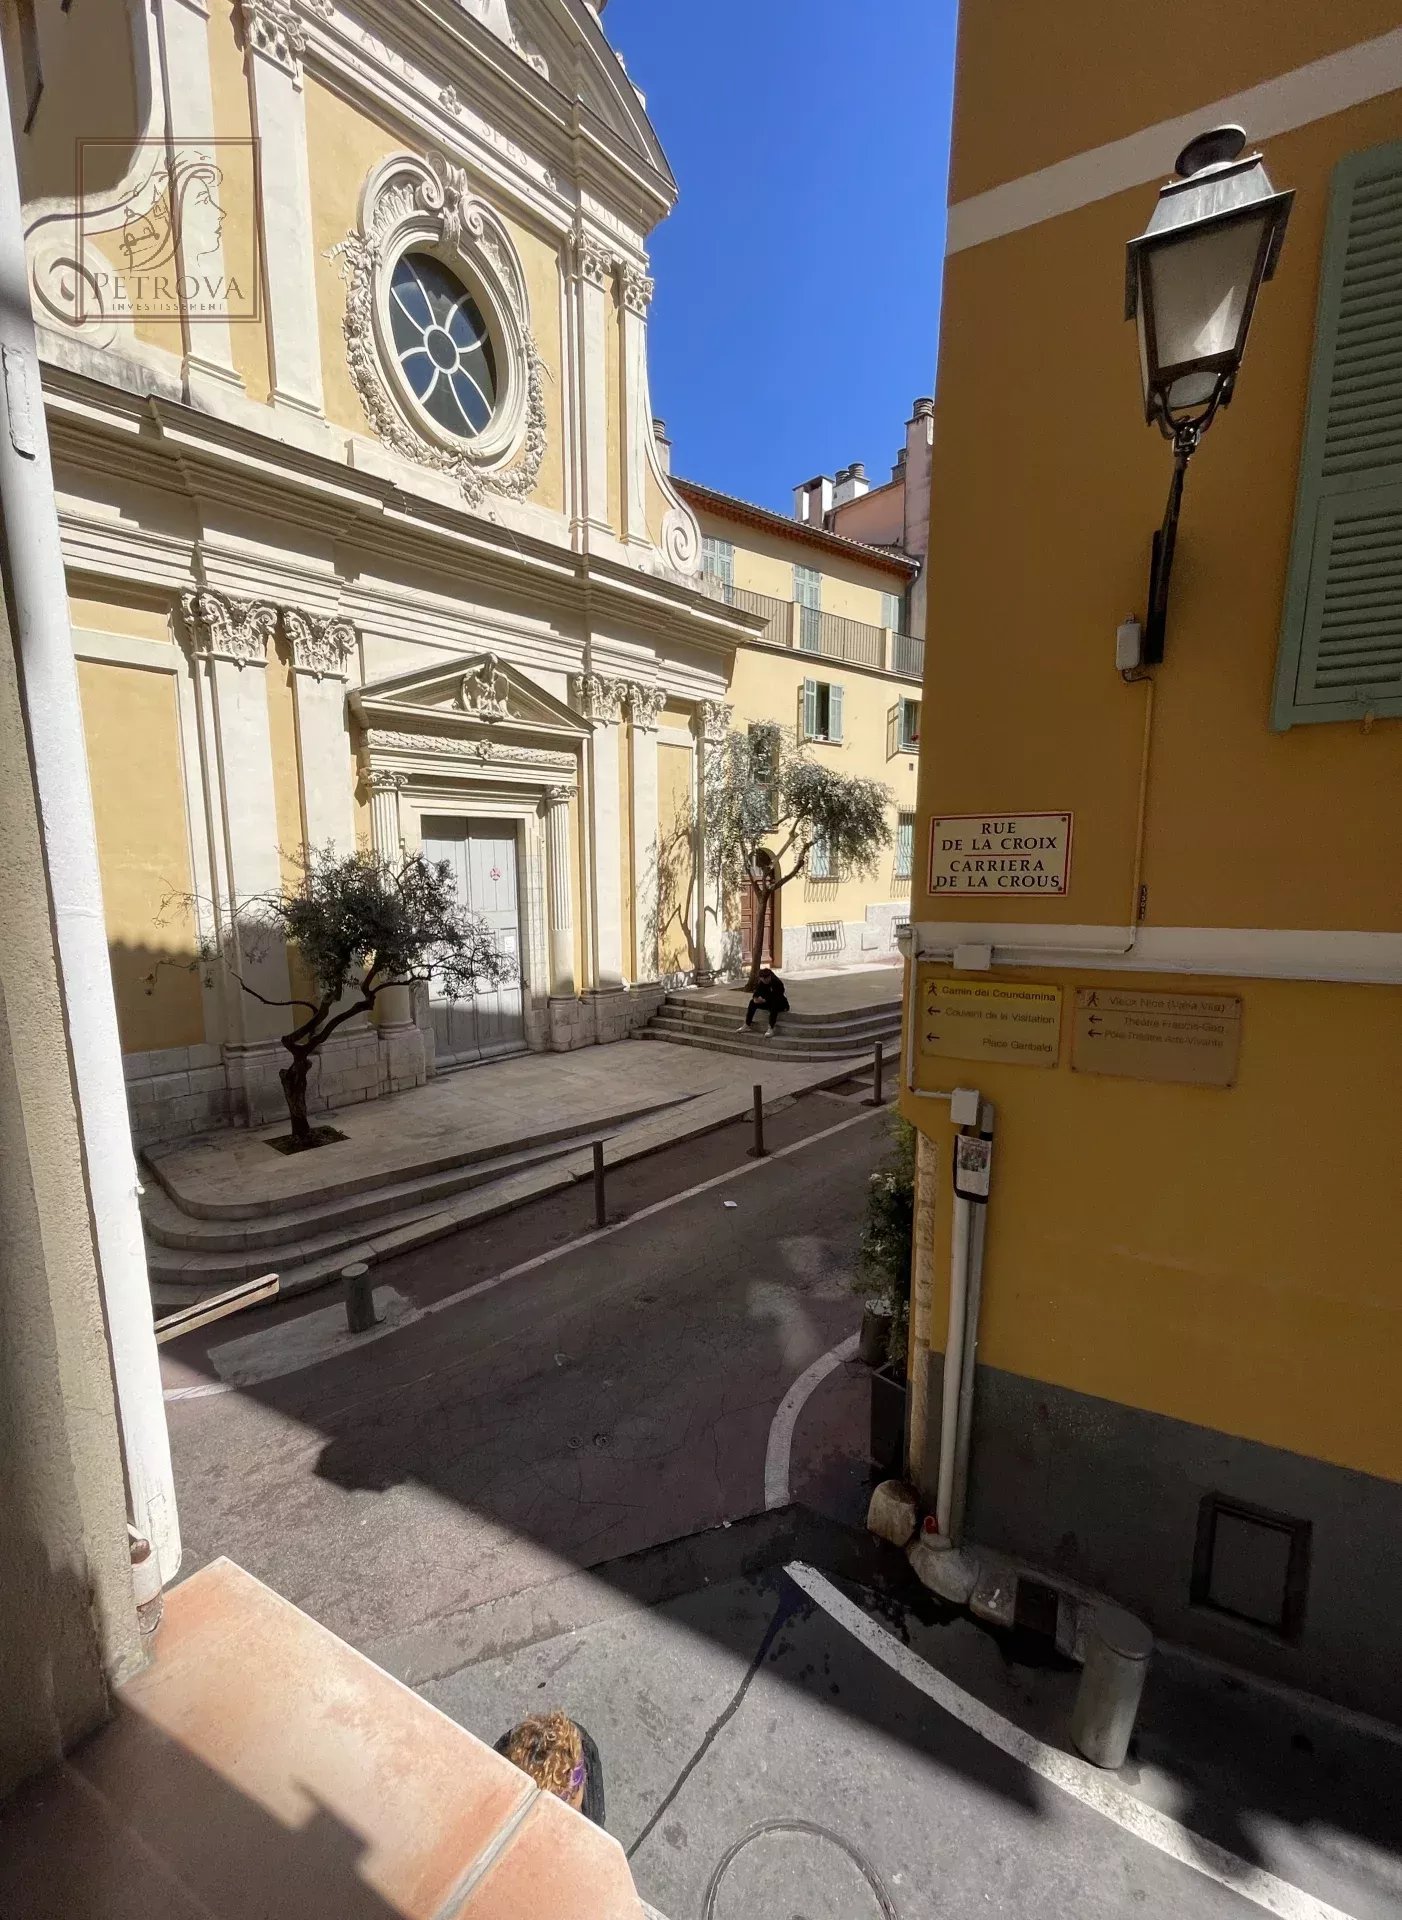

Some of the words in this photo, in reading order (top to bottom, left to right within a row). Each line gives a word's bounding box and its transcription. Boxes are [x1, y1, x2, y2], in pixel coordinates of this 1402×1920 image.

[480, 120, 528, 166] SPES
[981, 822, 1016, 835] RUE
[942, 839, 963, 851] DE
[972, 838, 992, 850] LA
[1001, 837, 1057, 849] CROIX
[950, 859, 1044, 872] CARRIERA
[936, 875, 957, 887] DE
[968, 875, 988, 887] LA
[997, 875, 1059, 887] CROUS
[942, 986, 972, 996] Camin
[985, 1011, 998, 1020] de
[1011, 1013, 1055, 1024] Visitation
[982, 1037, 1008, 1048] Place
[1011, 1040, 1053, 1053] Garibaldi
